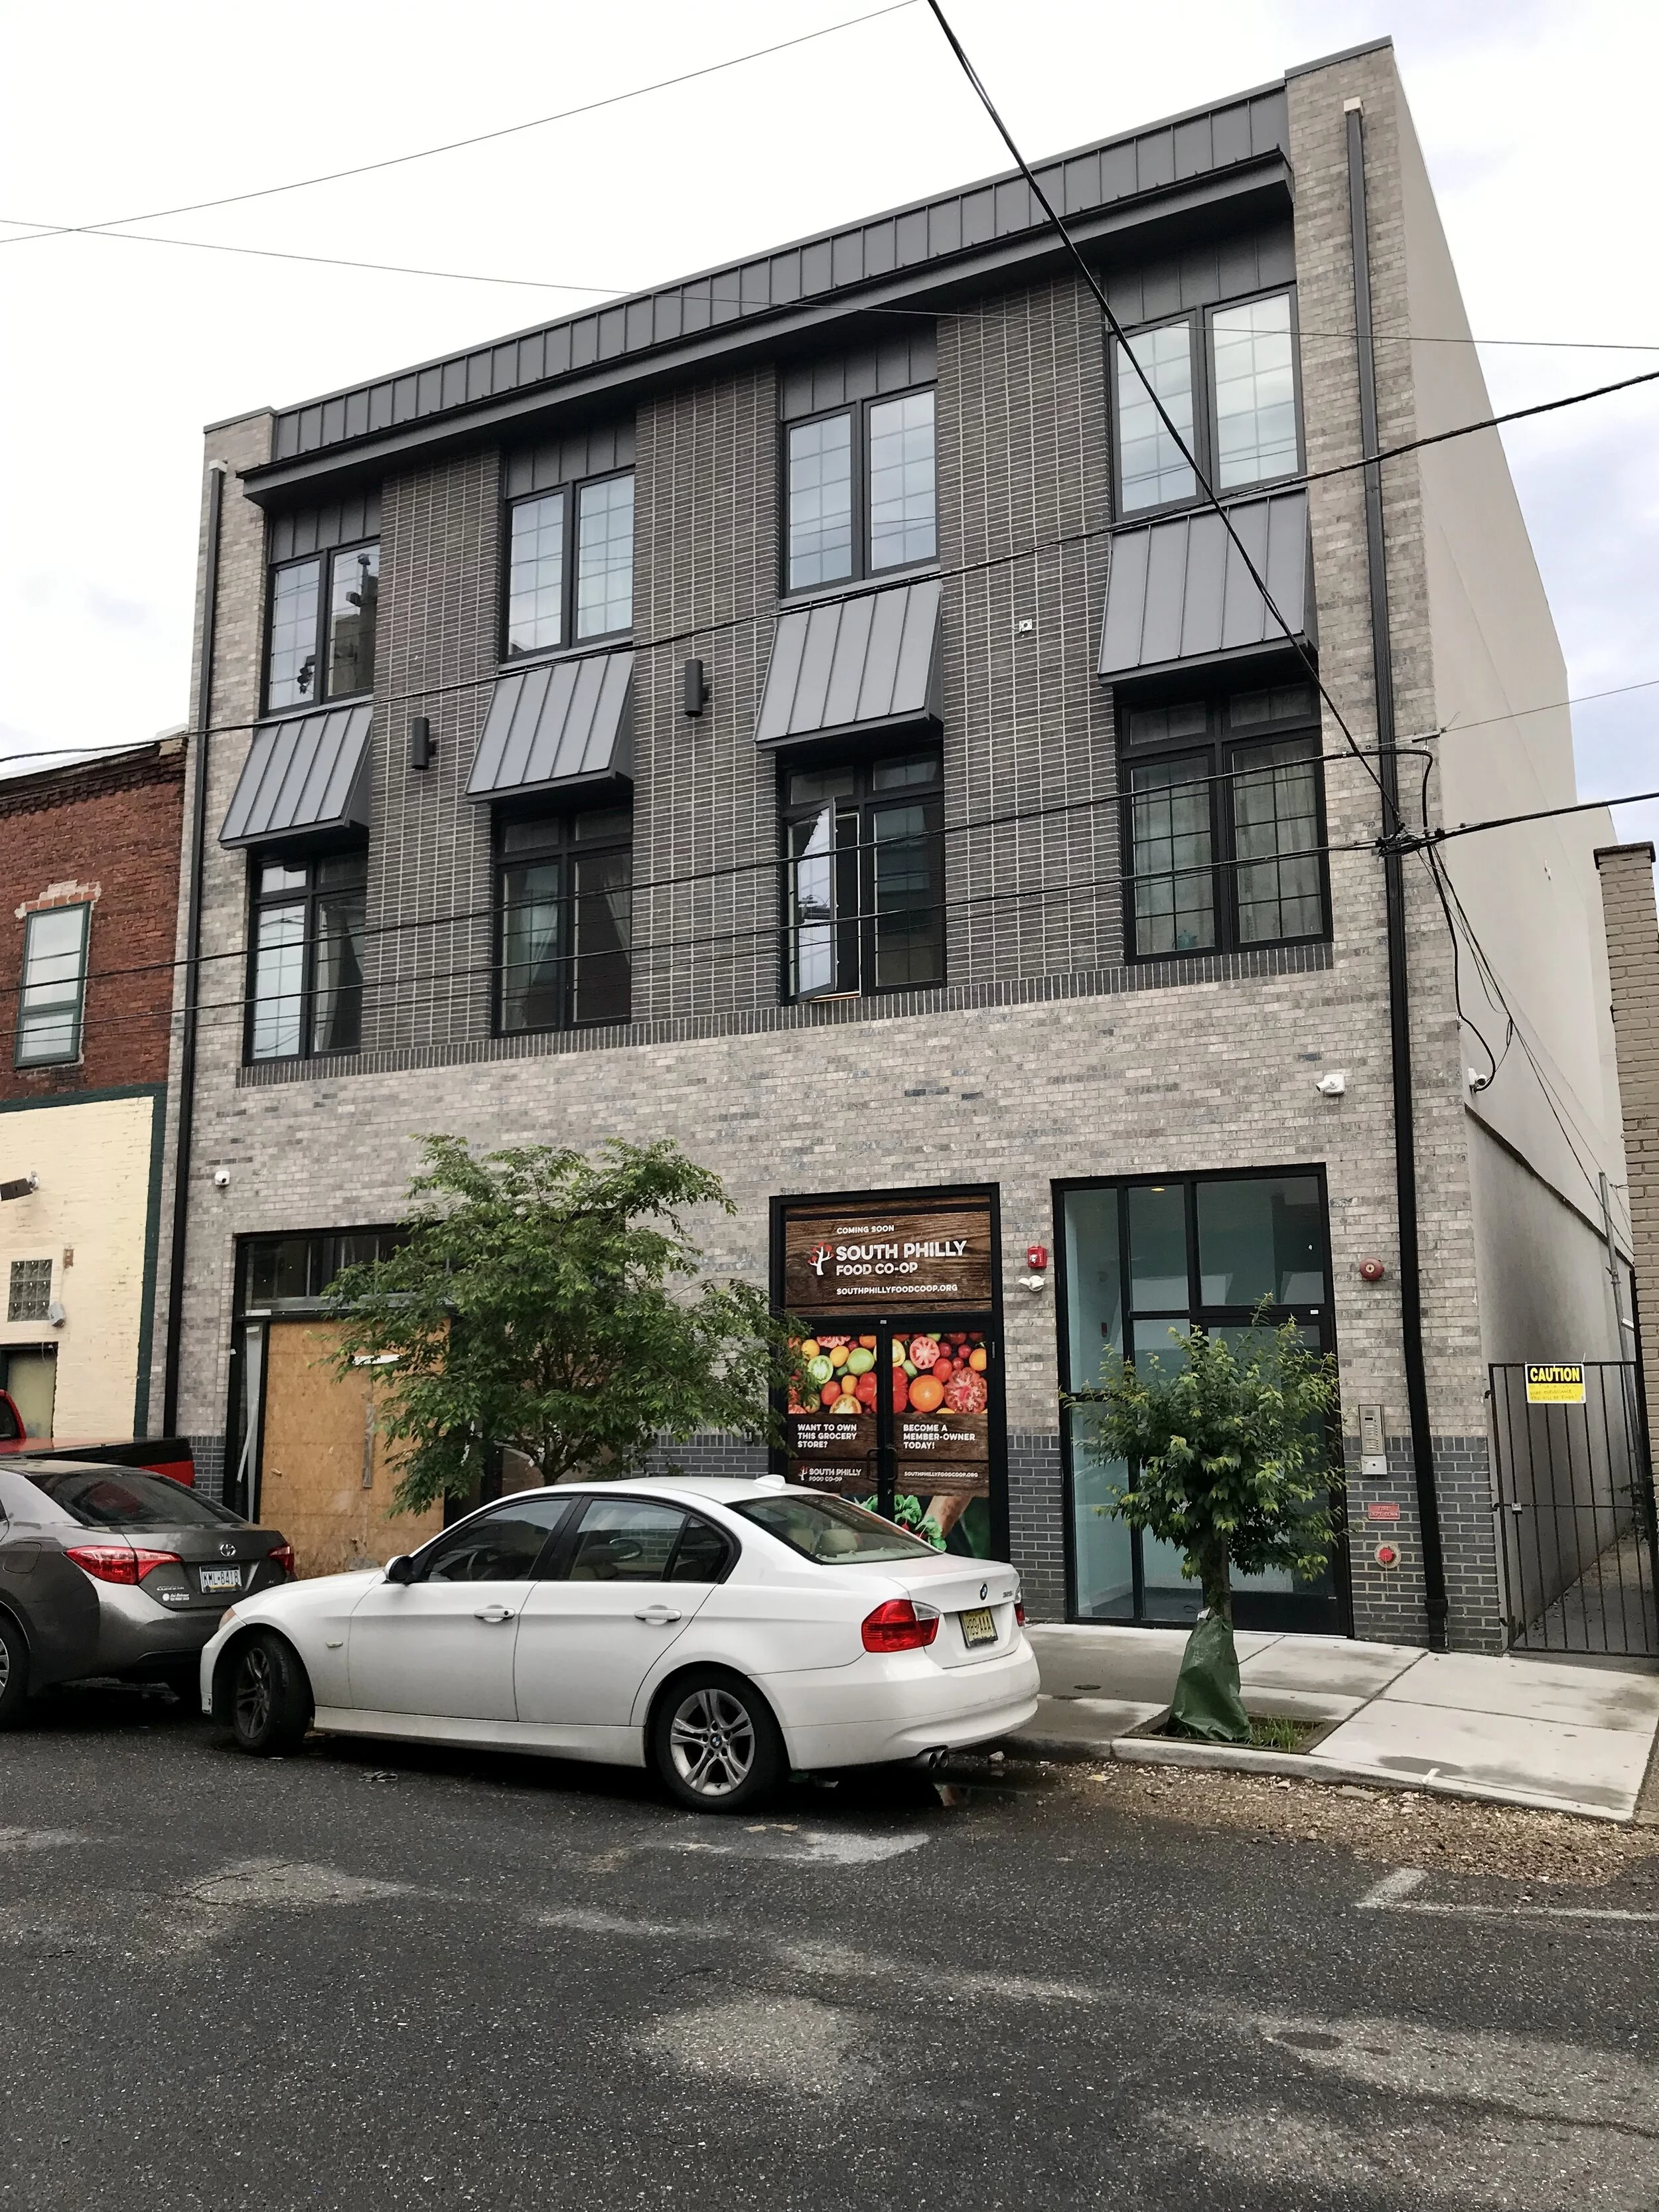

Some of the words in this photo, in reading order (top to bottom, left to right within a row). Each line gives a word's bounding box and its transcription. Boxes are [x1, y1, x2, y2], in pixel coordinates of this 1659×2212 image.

[836, 1243, 898, 1261] SOUTH
[904, 1240, 967, 1258] PHILLY
[836, 1264, 872, 1276] FOOD
[875, 1262, 918, 1274] CO-OP
[836, 1284, 958, 1295] SOUTHPHILLYFOODCOOP.ORG
[1530, 1367, 1580, 1382] CAUTION
